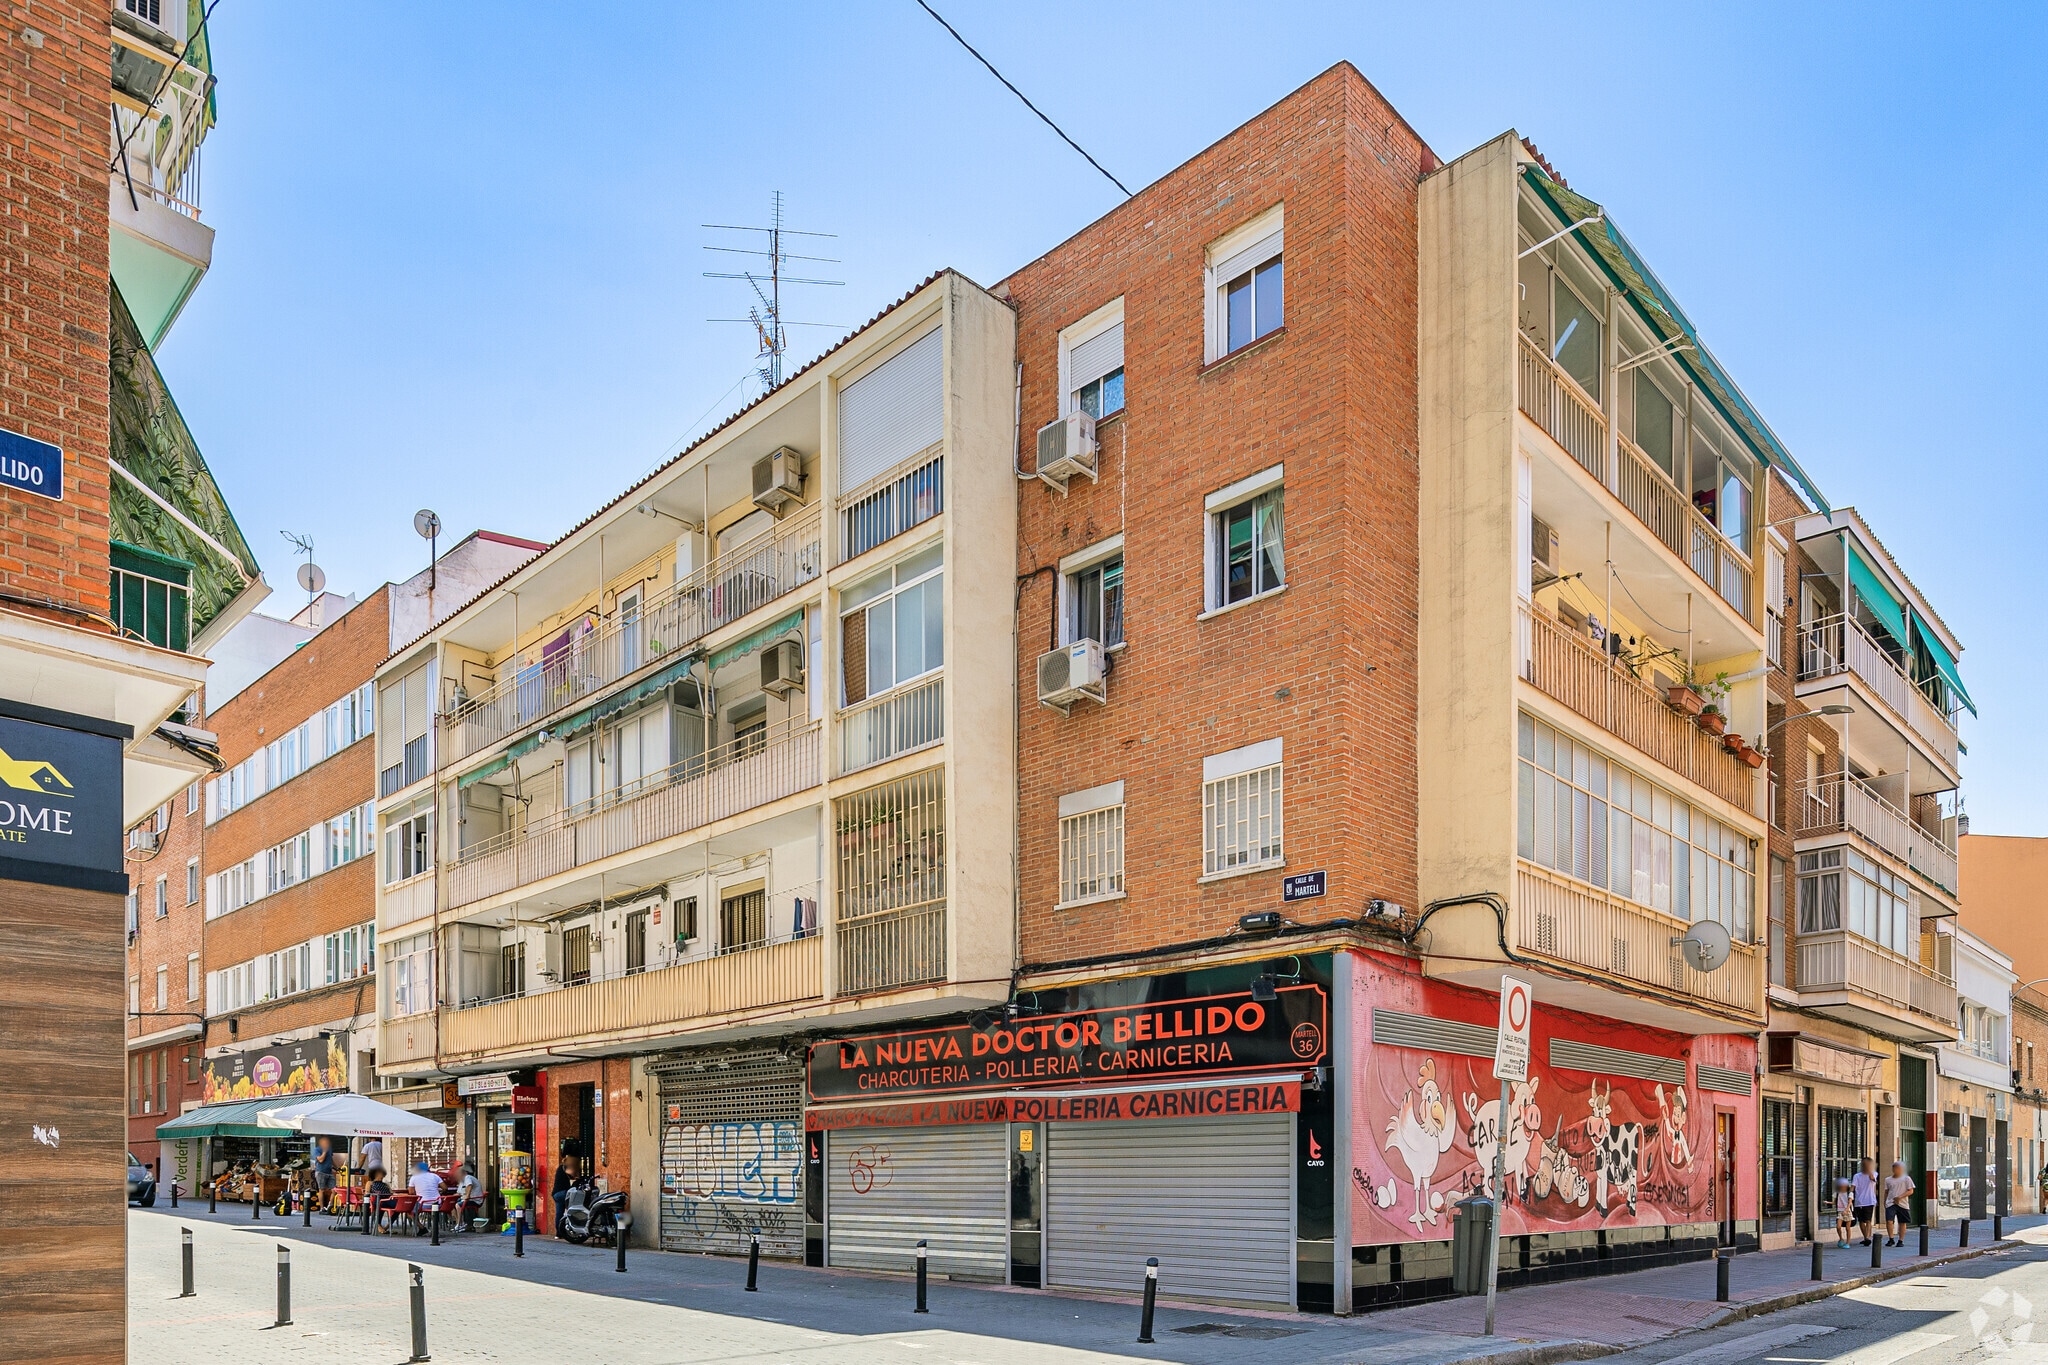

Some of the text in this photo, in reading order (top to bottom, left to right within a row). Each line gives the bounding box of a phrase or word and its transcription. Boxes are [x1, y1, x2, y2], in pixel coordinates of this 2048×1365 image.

[0, 456, 43, 485] LIDO
[1294, 884, 1320, 897] MARTELL
[1295, 876, 1307, 884] CALLE
[840, 1002, 1265, 1069] LA NUEVA DOCTOR BELLIDO
[1295, 1030, 1317, 1038] MARTELL
[1299, 1040, 1313, 1052] 36
[858, 1064, 970, 1090] CHARCUTERIA
[986, 1055, 1079, 1080] POLLERIA
[1098, 1041, 1233, 1071] CARNICERIA
[808, 1085, 1288, 1128] CHARCUTERIA LA NUEVA POLLERIA CARNICERIA
[1467, 1117, 1520, 1149] CARE
